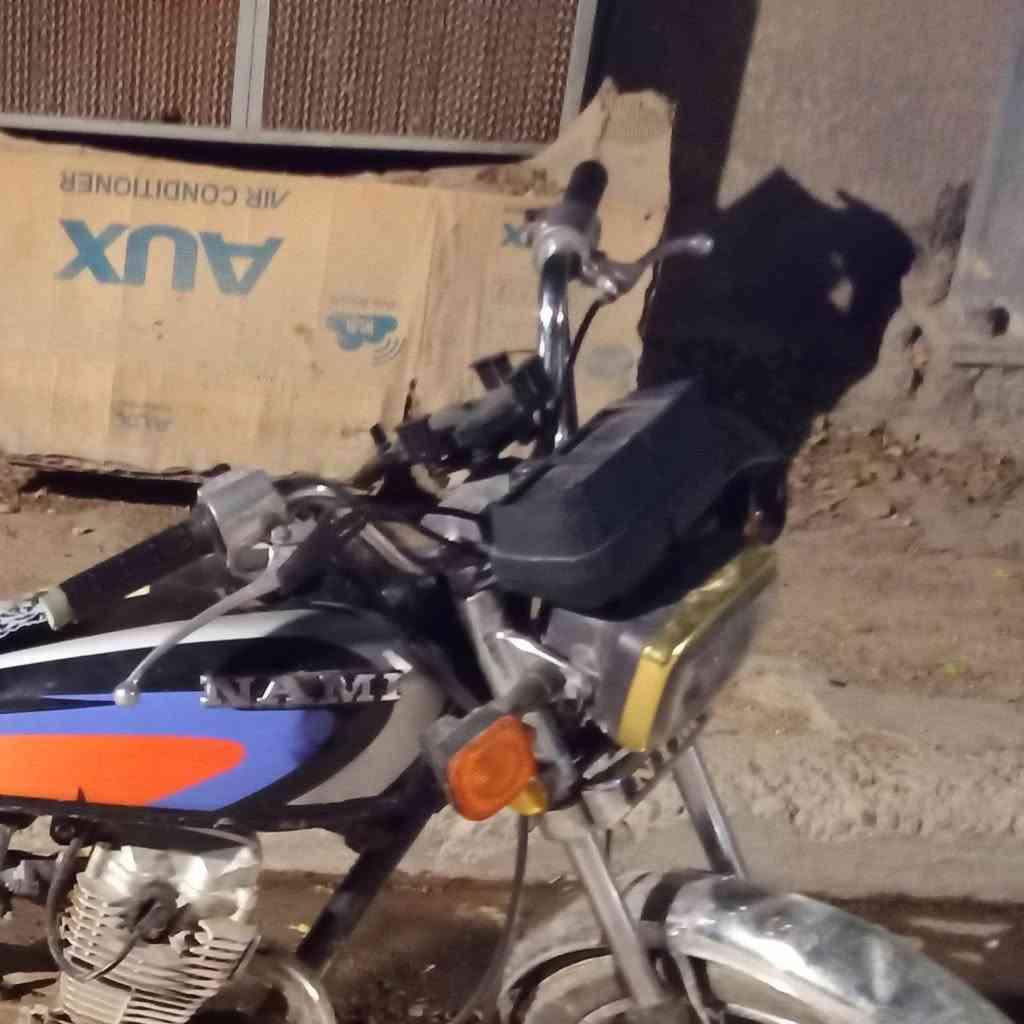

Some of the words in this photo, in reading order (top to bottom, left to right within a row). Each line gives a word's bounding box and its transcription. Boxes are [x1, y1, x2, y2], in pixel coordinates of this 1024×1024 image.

[59, 171, 238, 208] CONDITIONER
[245, 186, 291, 210] AIR
[55, 219, 284, 296] AUX
